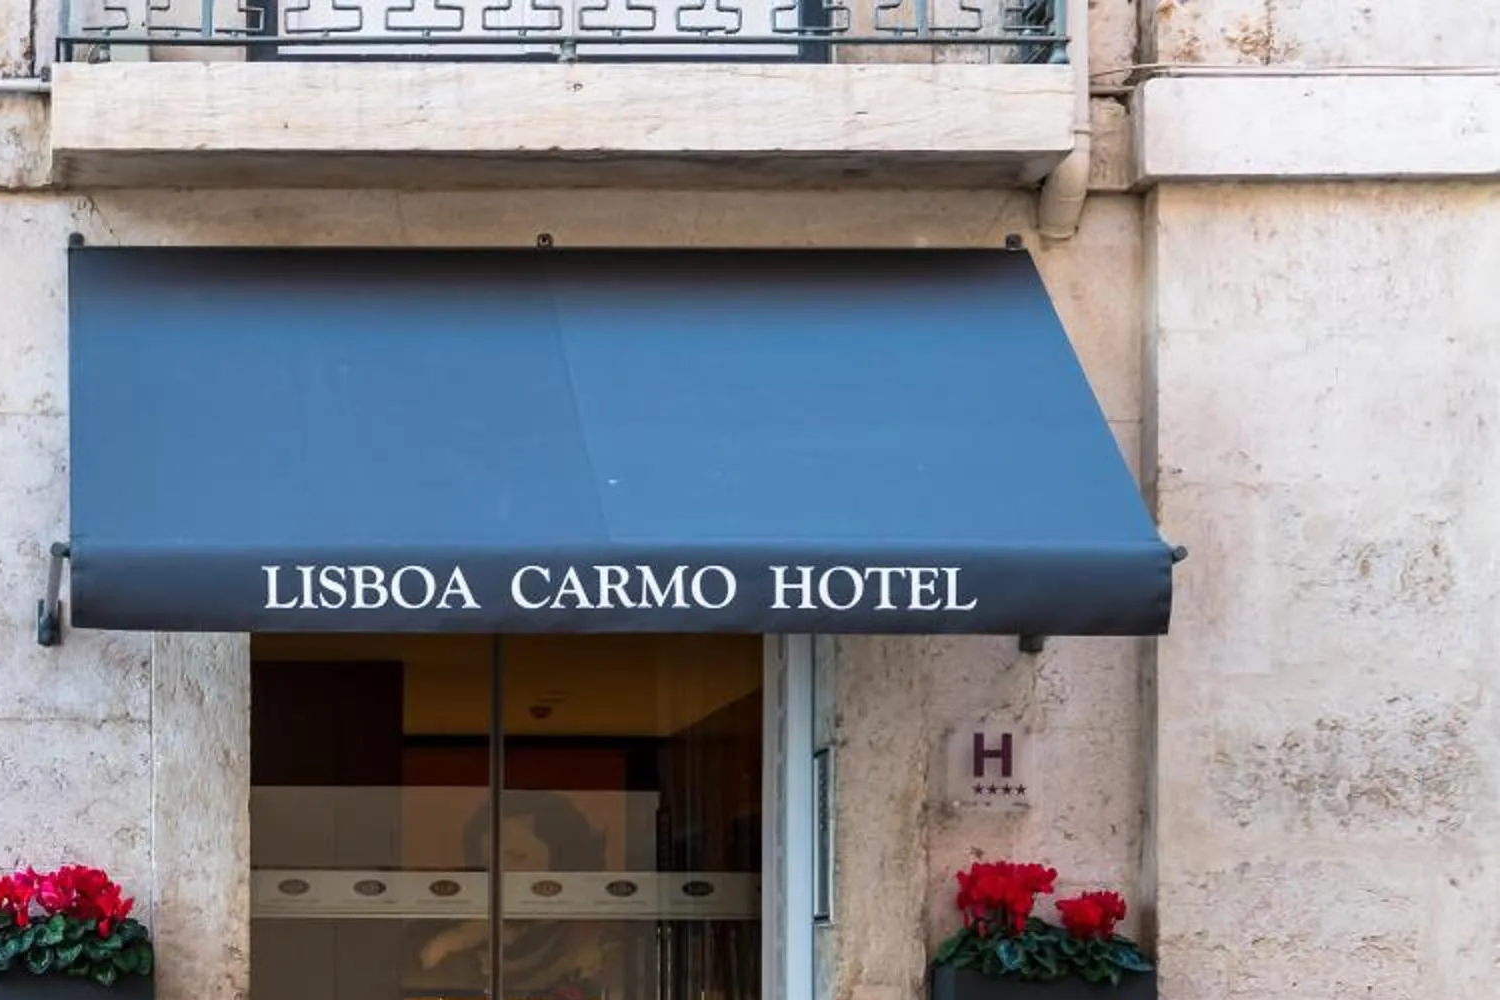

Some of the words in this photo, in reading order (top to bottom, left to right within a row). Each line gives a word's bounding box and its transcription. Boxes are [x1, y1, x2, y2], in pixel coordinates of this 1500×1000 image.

[262, 564, 481, 609] LISBOA
[510, 564, 737, 609] CARMO
[769, 564, 977, 611] HOTEL
[973, 732, 1013, 778] H
